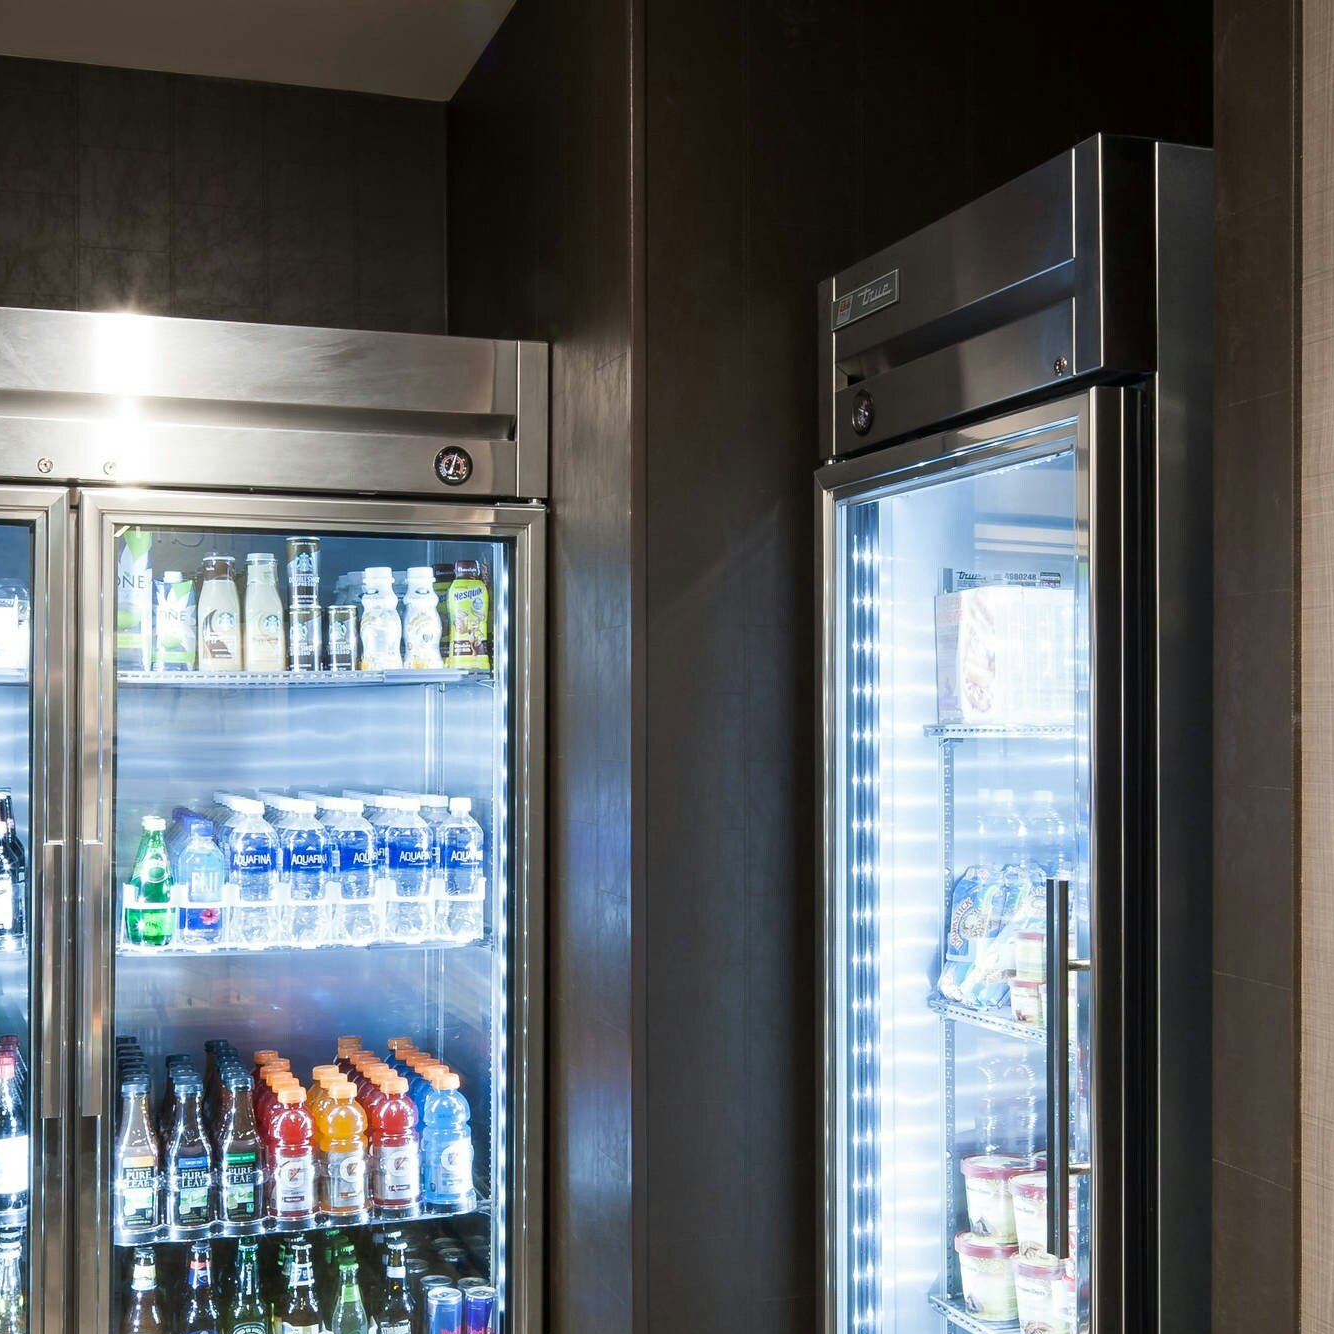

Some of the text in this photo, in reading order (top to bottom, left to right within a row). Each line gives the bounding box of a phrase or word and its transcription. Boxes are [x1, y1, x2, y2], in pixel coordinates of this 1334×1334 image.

[233, 853, 271, 866] AQUAFINA
[126, 1169, 152, 1180] PURE
[181, 1171, 206, 1180] PURE
